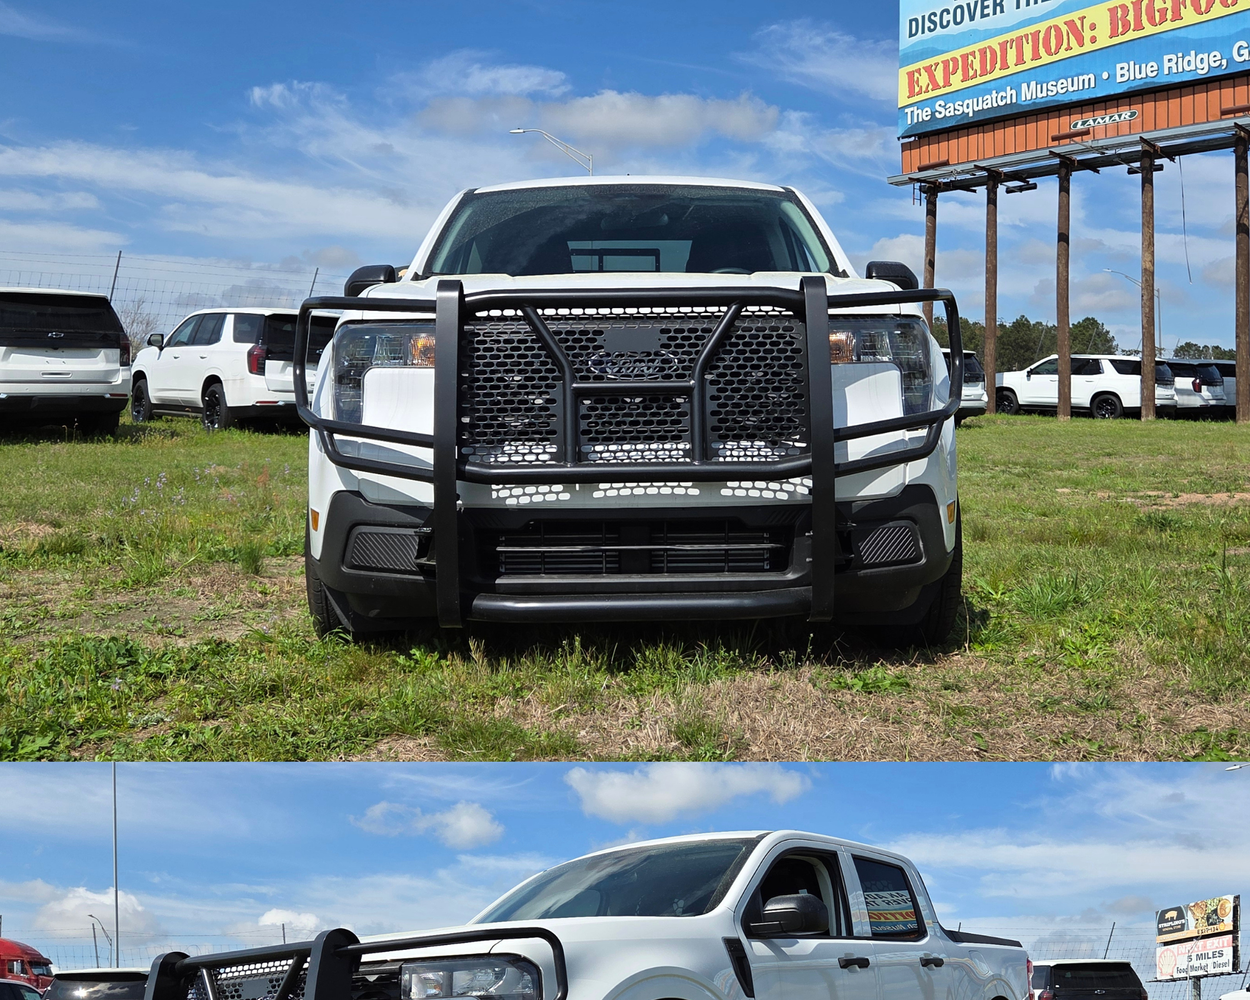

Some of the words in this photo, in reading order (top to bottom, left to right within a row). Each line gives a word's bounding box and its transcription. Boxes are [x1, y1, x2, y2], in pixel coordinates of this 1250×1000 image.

[908, 0, 1005, 39] DISCOVER
[906, 16, 1097, 99] EXPEDITION:
[904, 106, 932, 125] The
[934, 86, 1016, 118] Sasquatch
[1021, 72, 1096, 102] Museum
[1115, 60, 1158, 83] Blue
[1163, 50, 1228, 75] Ridge,
[1076, 112, 1132, 127] LAMAR
[1177, 941, 1204, 954] NEXT
[1206, 937, 1229, 949] EXIT
[1195, 949, 1224, 962] MILES
[1212, 959, 1230, 970] Diesel
